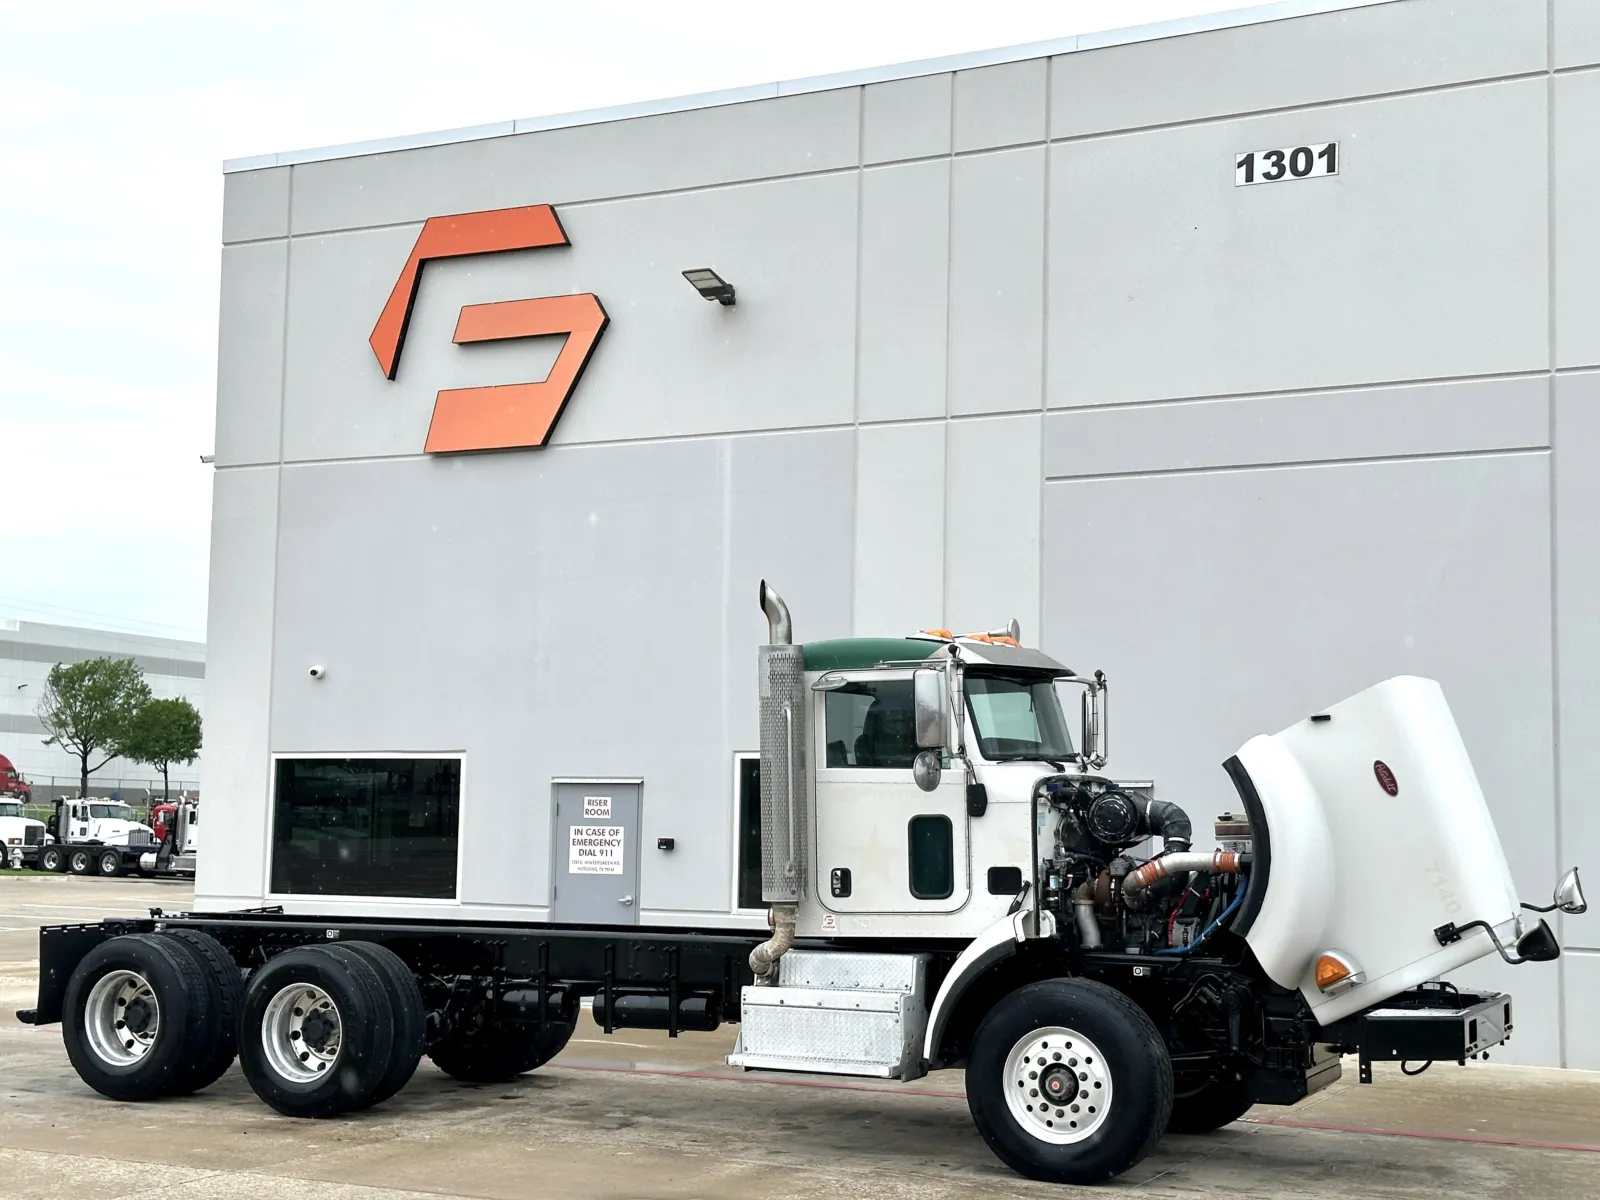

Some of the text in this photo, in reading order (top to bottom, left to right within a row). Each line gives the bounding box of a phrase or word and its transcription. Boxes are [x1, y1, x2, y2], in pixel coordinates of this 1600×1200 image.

[1236, 142, 1337, 184] 1301
[1374, 763, 1398, 793] Peterbilt
[587, 798, 608, 807] RISER
[585, 808, 610, 816] ROOM
[574, 828, 620, 837] IN CASE OF
[572, 838, 621, 847] EMERGENCY
[578, 848, 613, 857] DIAL 911
